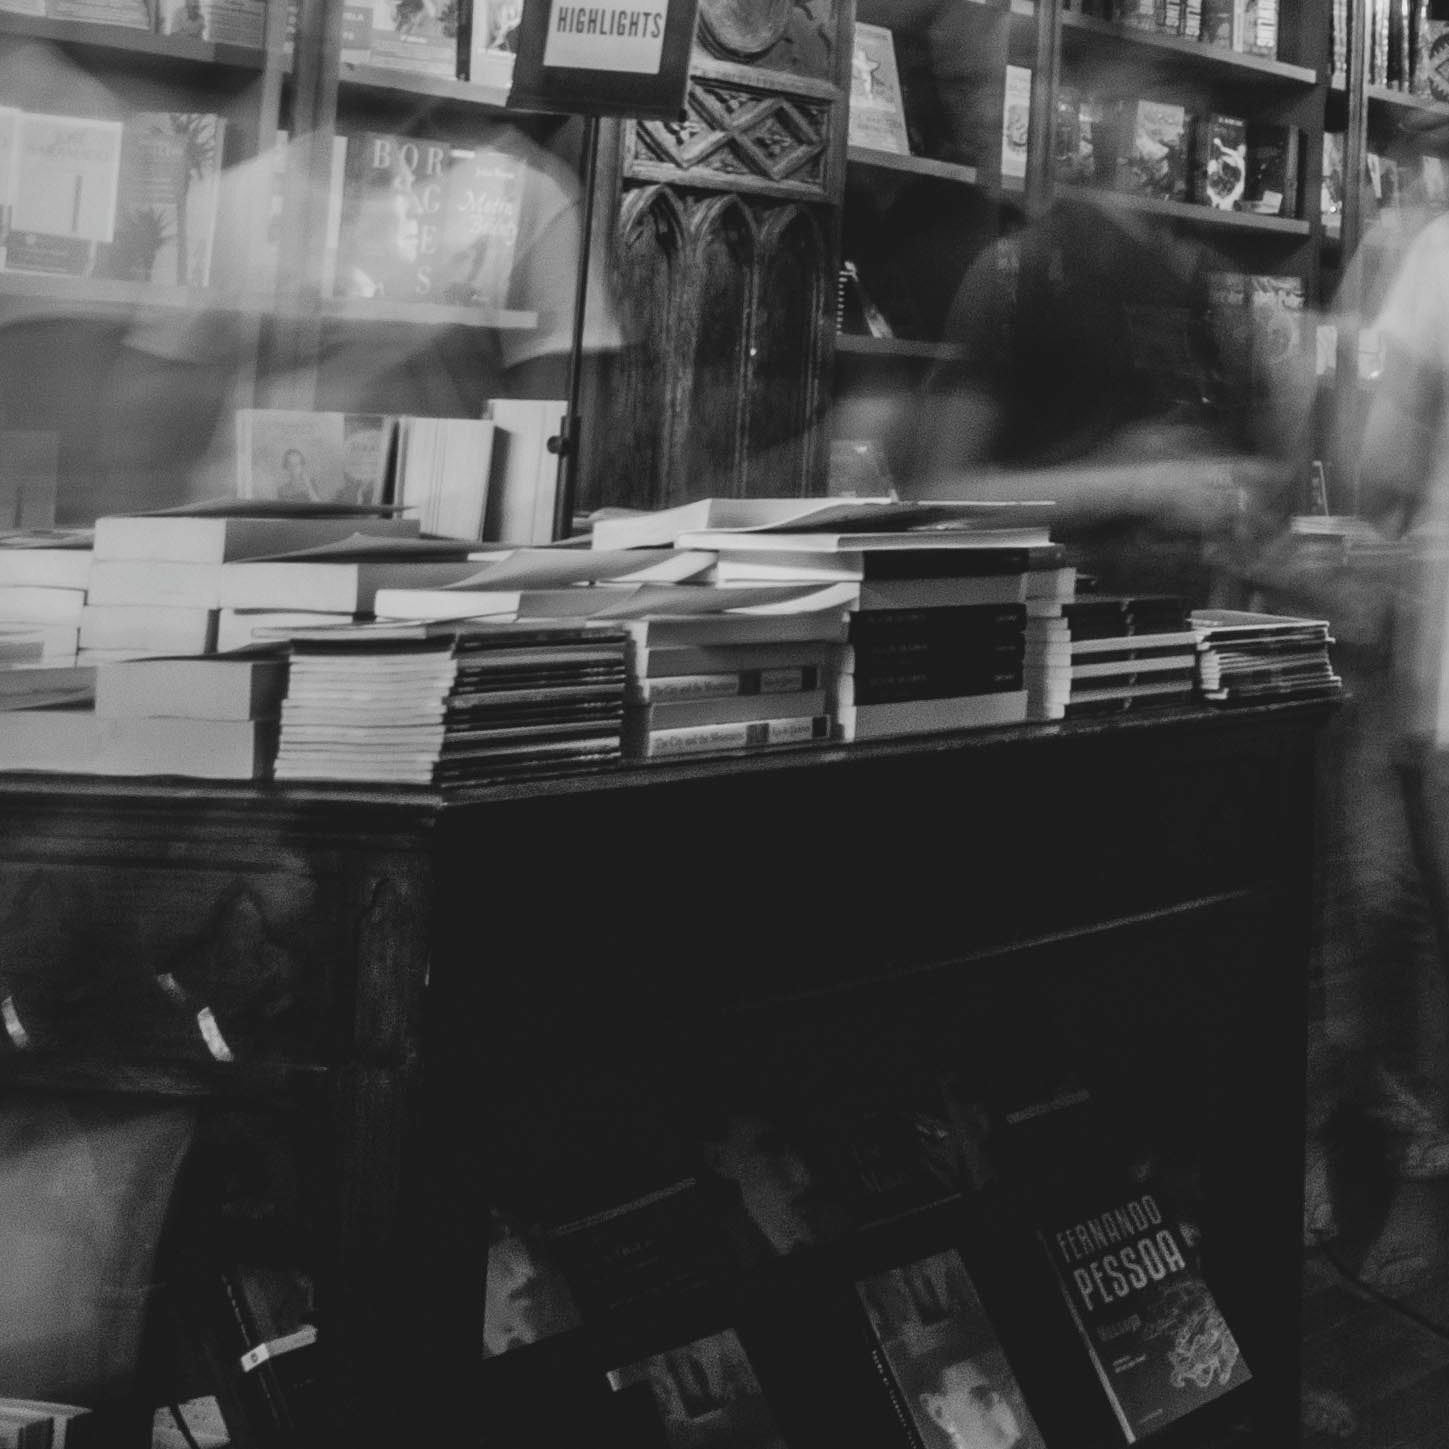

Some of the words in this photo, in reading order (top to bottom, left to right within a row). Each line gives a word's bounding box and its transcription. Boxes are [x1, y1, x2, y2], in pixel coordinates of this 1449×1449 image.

[556, 5, 664, 39] HIGHLIGHTS
[1055, 1195, 1163, 1264] FERNANDO
[1073, 1229, 1186, 1312] PESSOA
